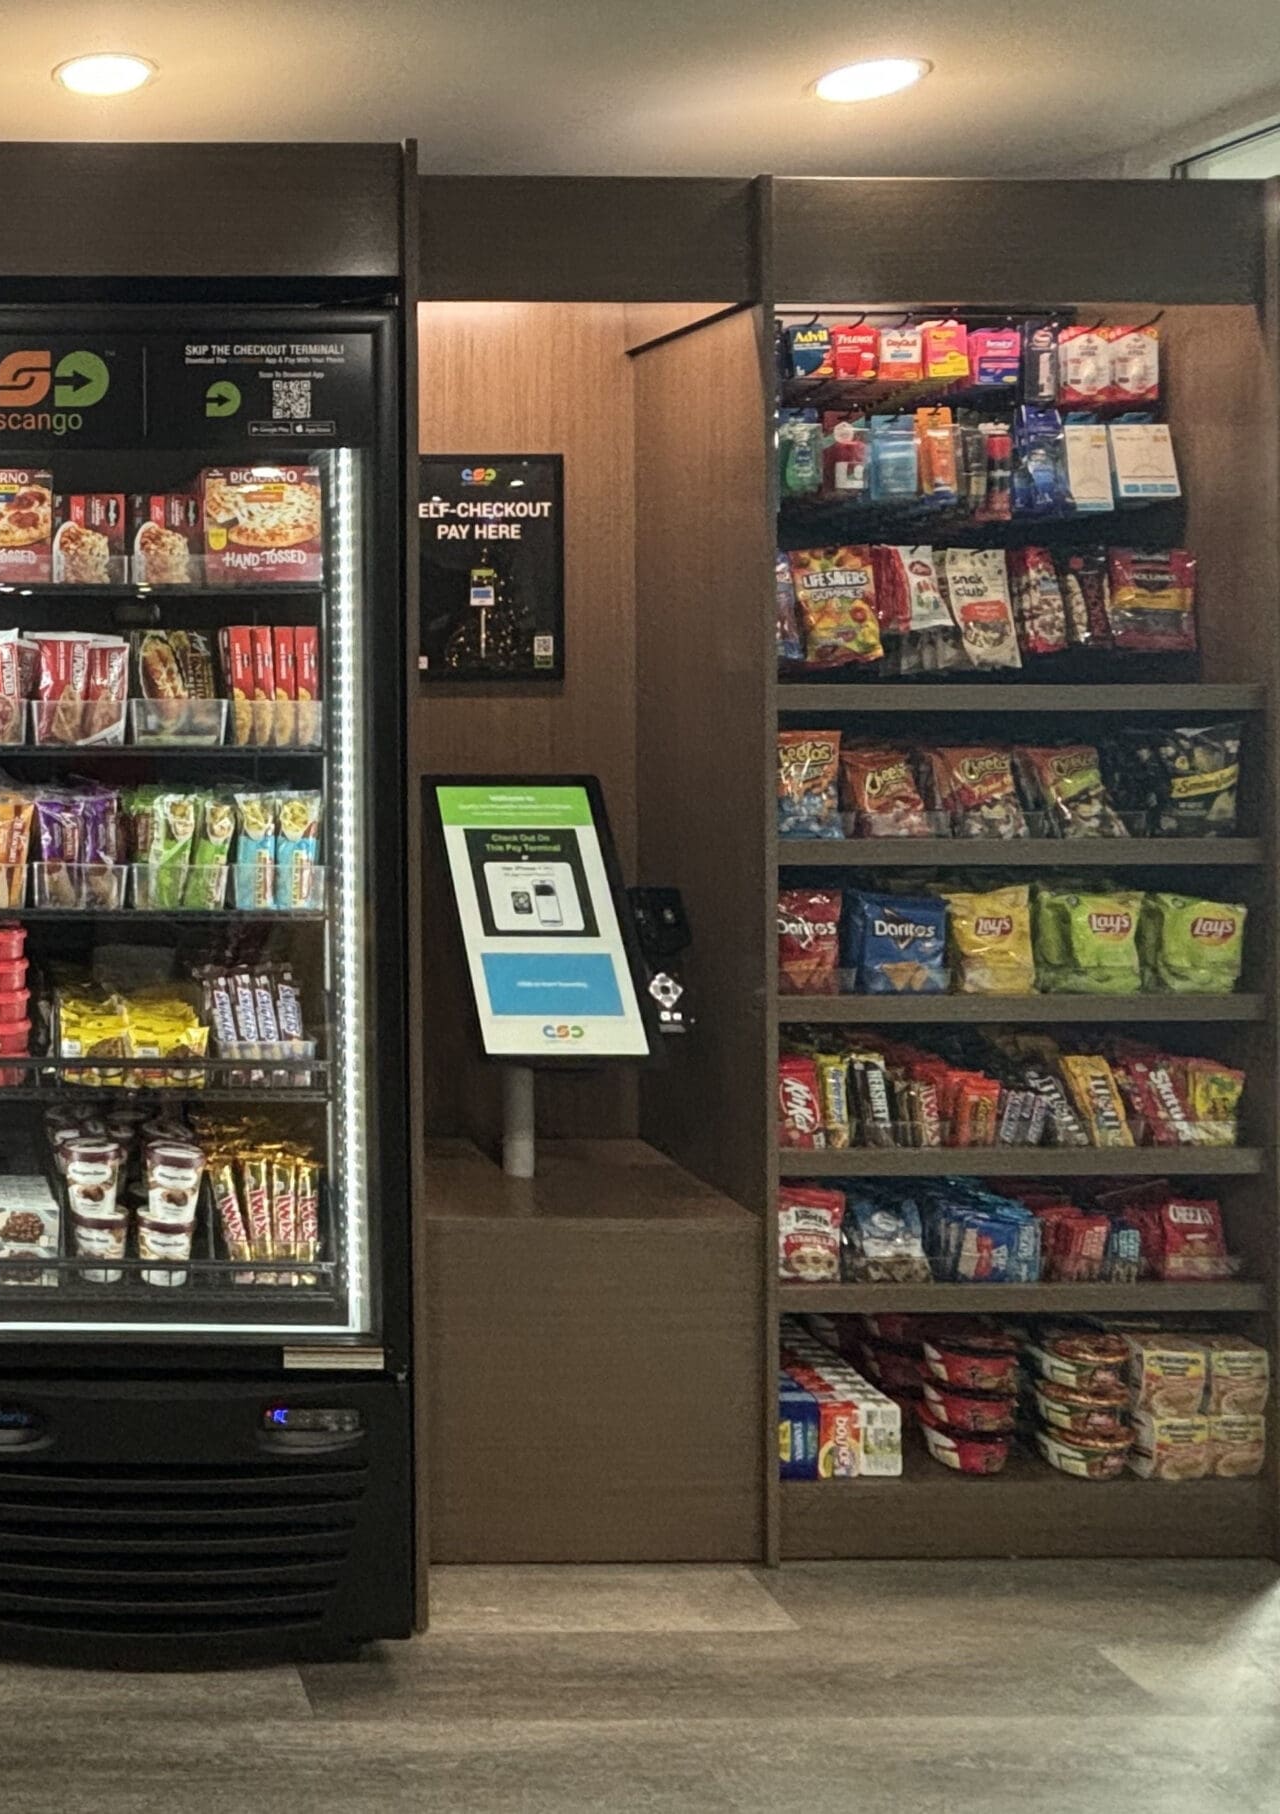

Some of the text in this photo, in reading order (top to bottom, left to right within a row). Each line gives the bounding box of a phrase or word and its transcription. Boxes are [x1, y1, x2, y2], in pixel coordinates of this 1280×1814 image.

[794, 330, 829, 343] Advil
[837, 334, 874, 344] TYLENOL
[185, 344, 345, 356] SKIP THE CHECKOUT TERMINAL!
[437, 524, 522, 540] PAY HERE
[491, 834, 518, 842] Check
[519, 834, 536, 842] Out
[777, 919, 837, 935] Doritos
[875, 920, 936, 937] Doritos
